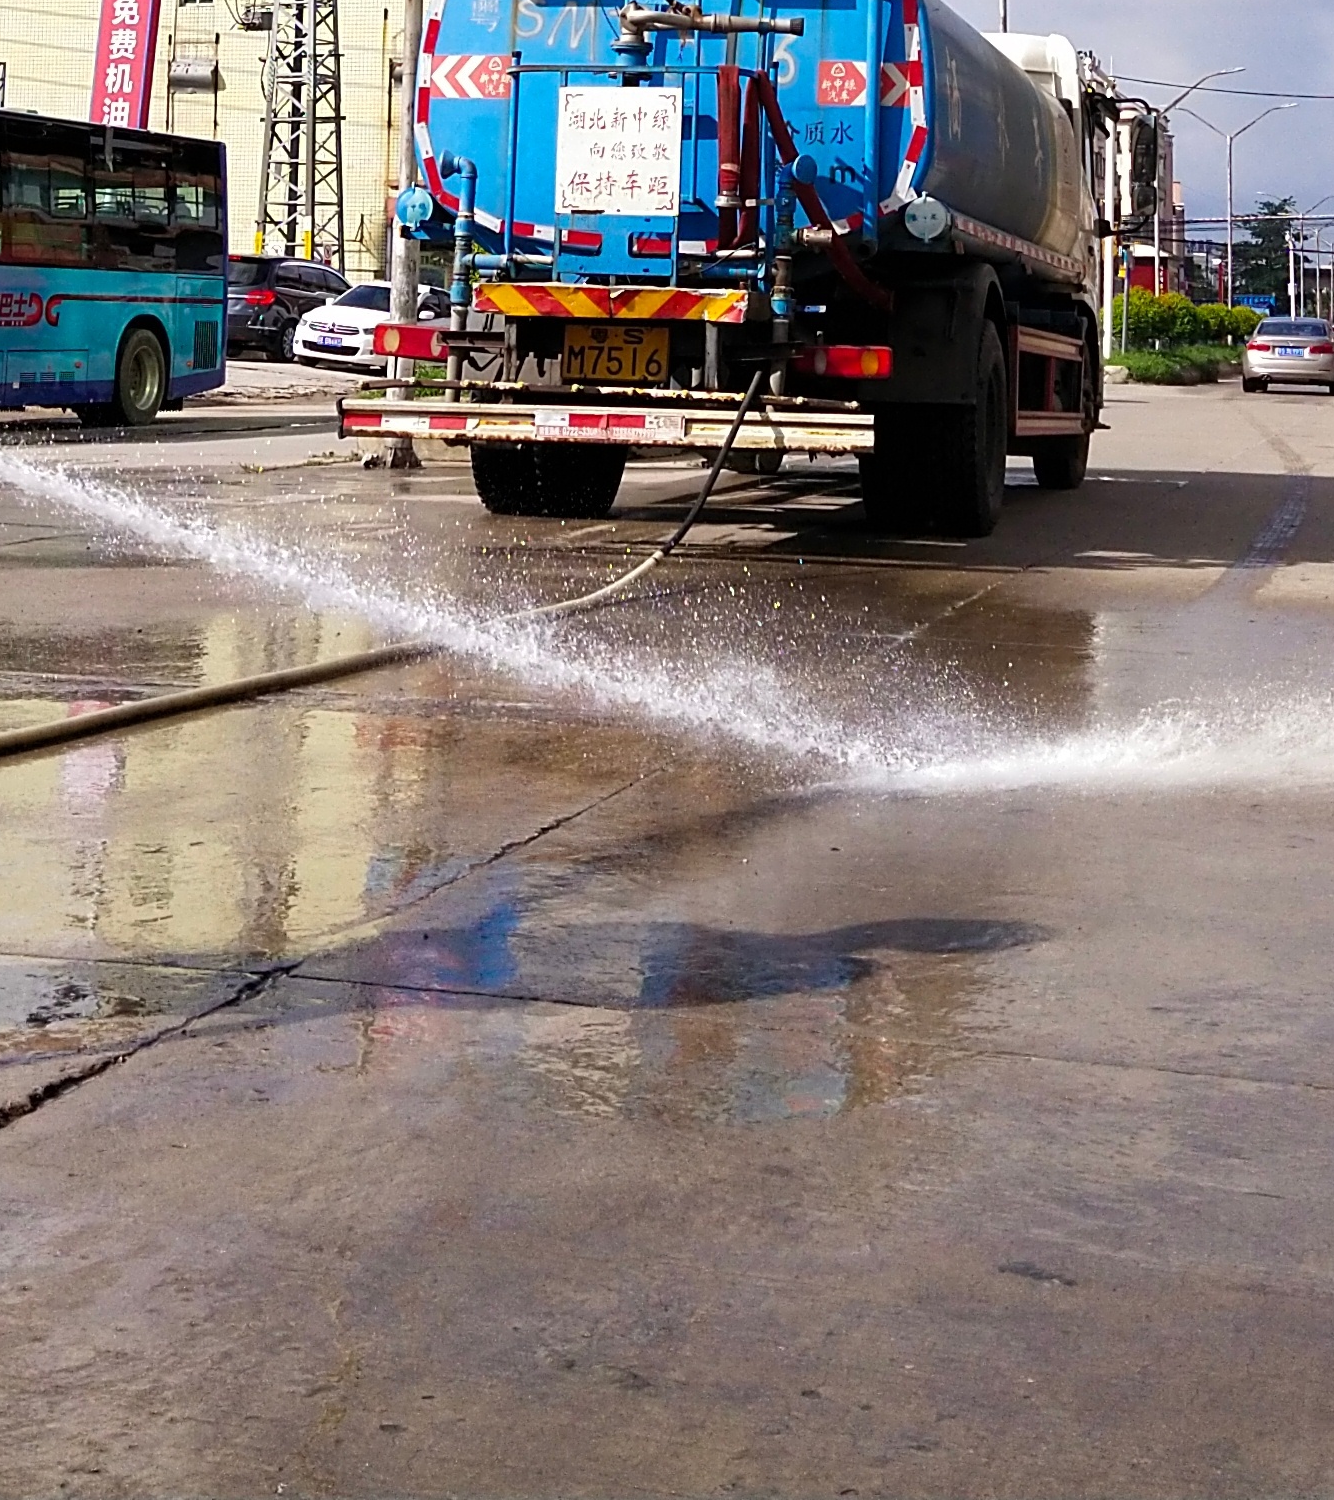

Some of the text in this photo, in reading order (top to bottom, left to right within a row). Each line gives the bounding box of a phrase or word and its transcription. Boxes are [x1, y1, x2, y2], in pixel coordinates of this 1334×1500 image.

[568, 106, 672, 133] 湖北新中绿
[589, 140, 671, 161] 向您致敬
[567, 169, 669, 200] 保持车距
[566, 345, 662, 377] M7516
